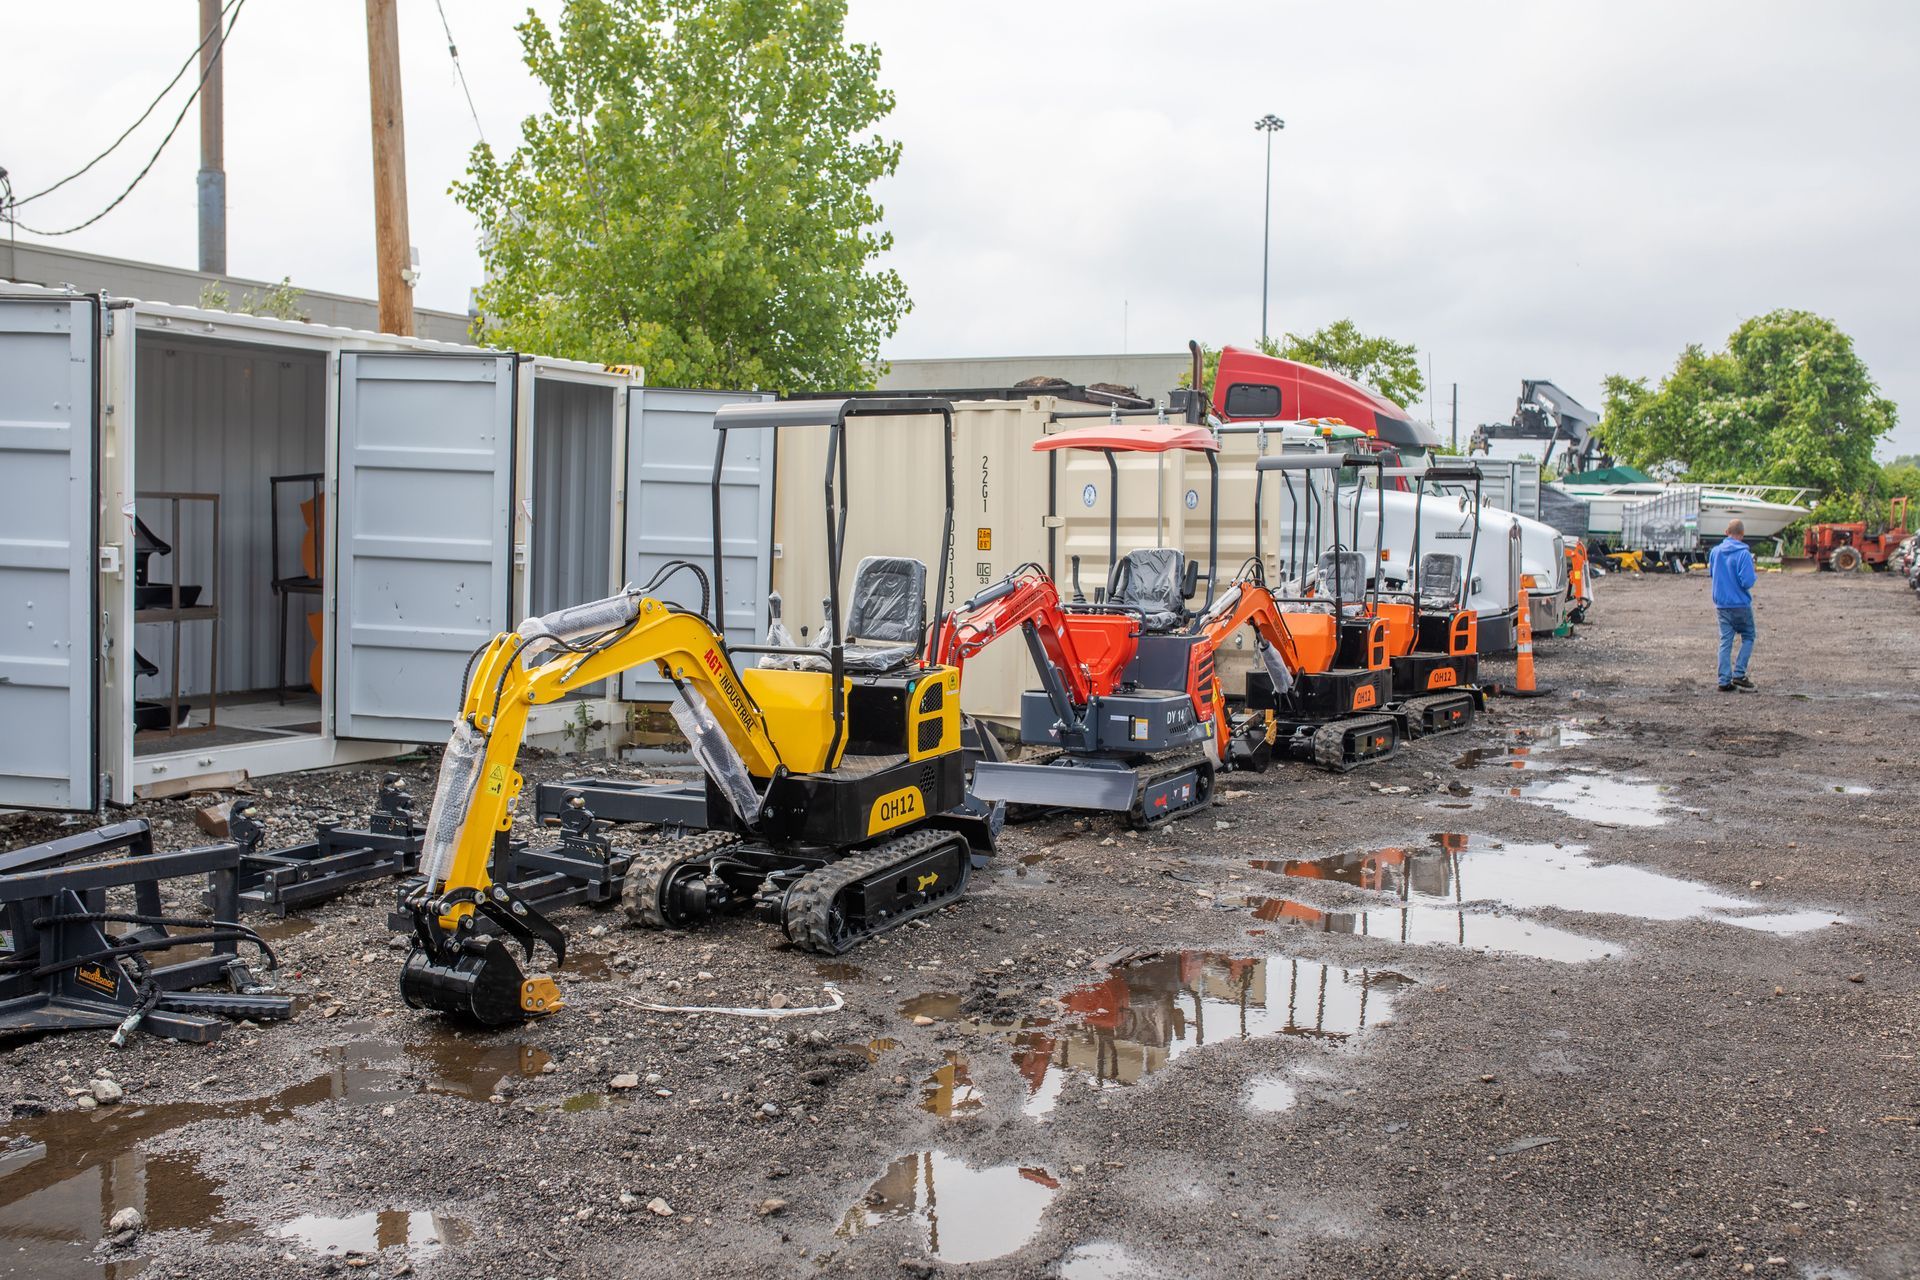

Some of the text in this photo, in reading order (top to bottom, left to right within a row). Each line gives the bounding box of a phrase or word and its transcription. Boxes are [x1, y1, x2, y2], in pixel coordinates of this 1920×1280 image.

[980, 577, 989, 585] 33
[1434, 671, 1452, 683] QH12
[704, 648, 755, 733] AGT INDUSTRIAL
[1167, 710, 1185, 725] DY 14
[881, 793, 915, 821] QH12
